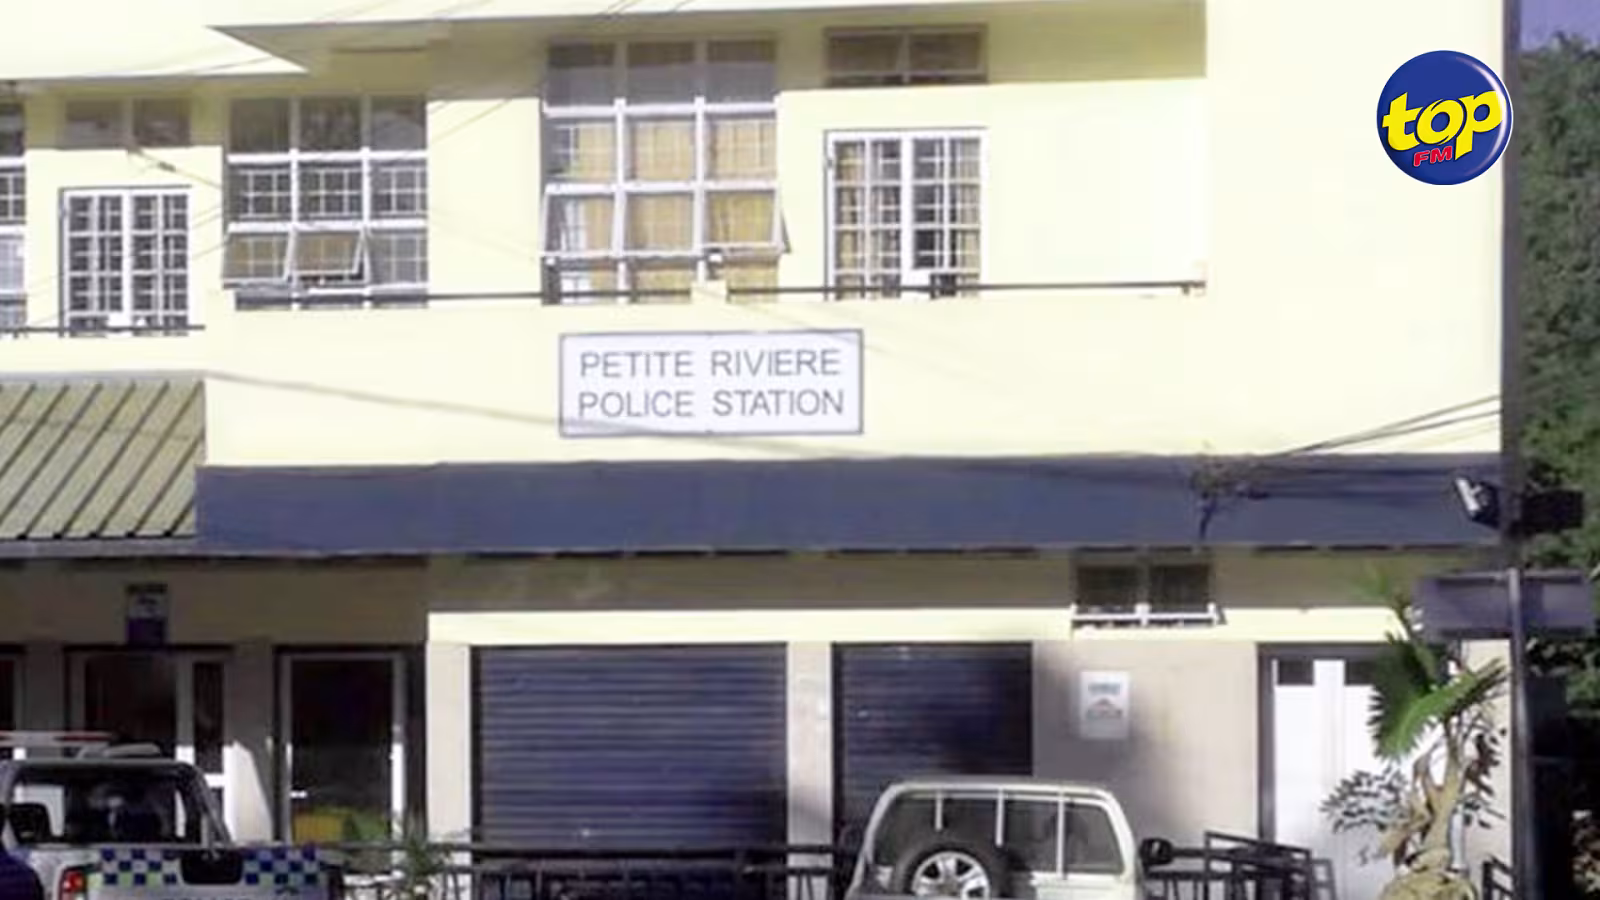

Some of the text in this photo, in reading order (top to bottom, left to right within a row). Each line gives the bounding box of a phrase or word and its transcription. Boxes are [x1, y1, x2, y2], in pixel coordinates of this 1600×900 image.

[580, 348, 841, 377] PETITE RIVIERE
[579, 388, 844, 418] POLICE STATION
